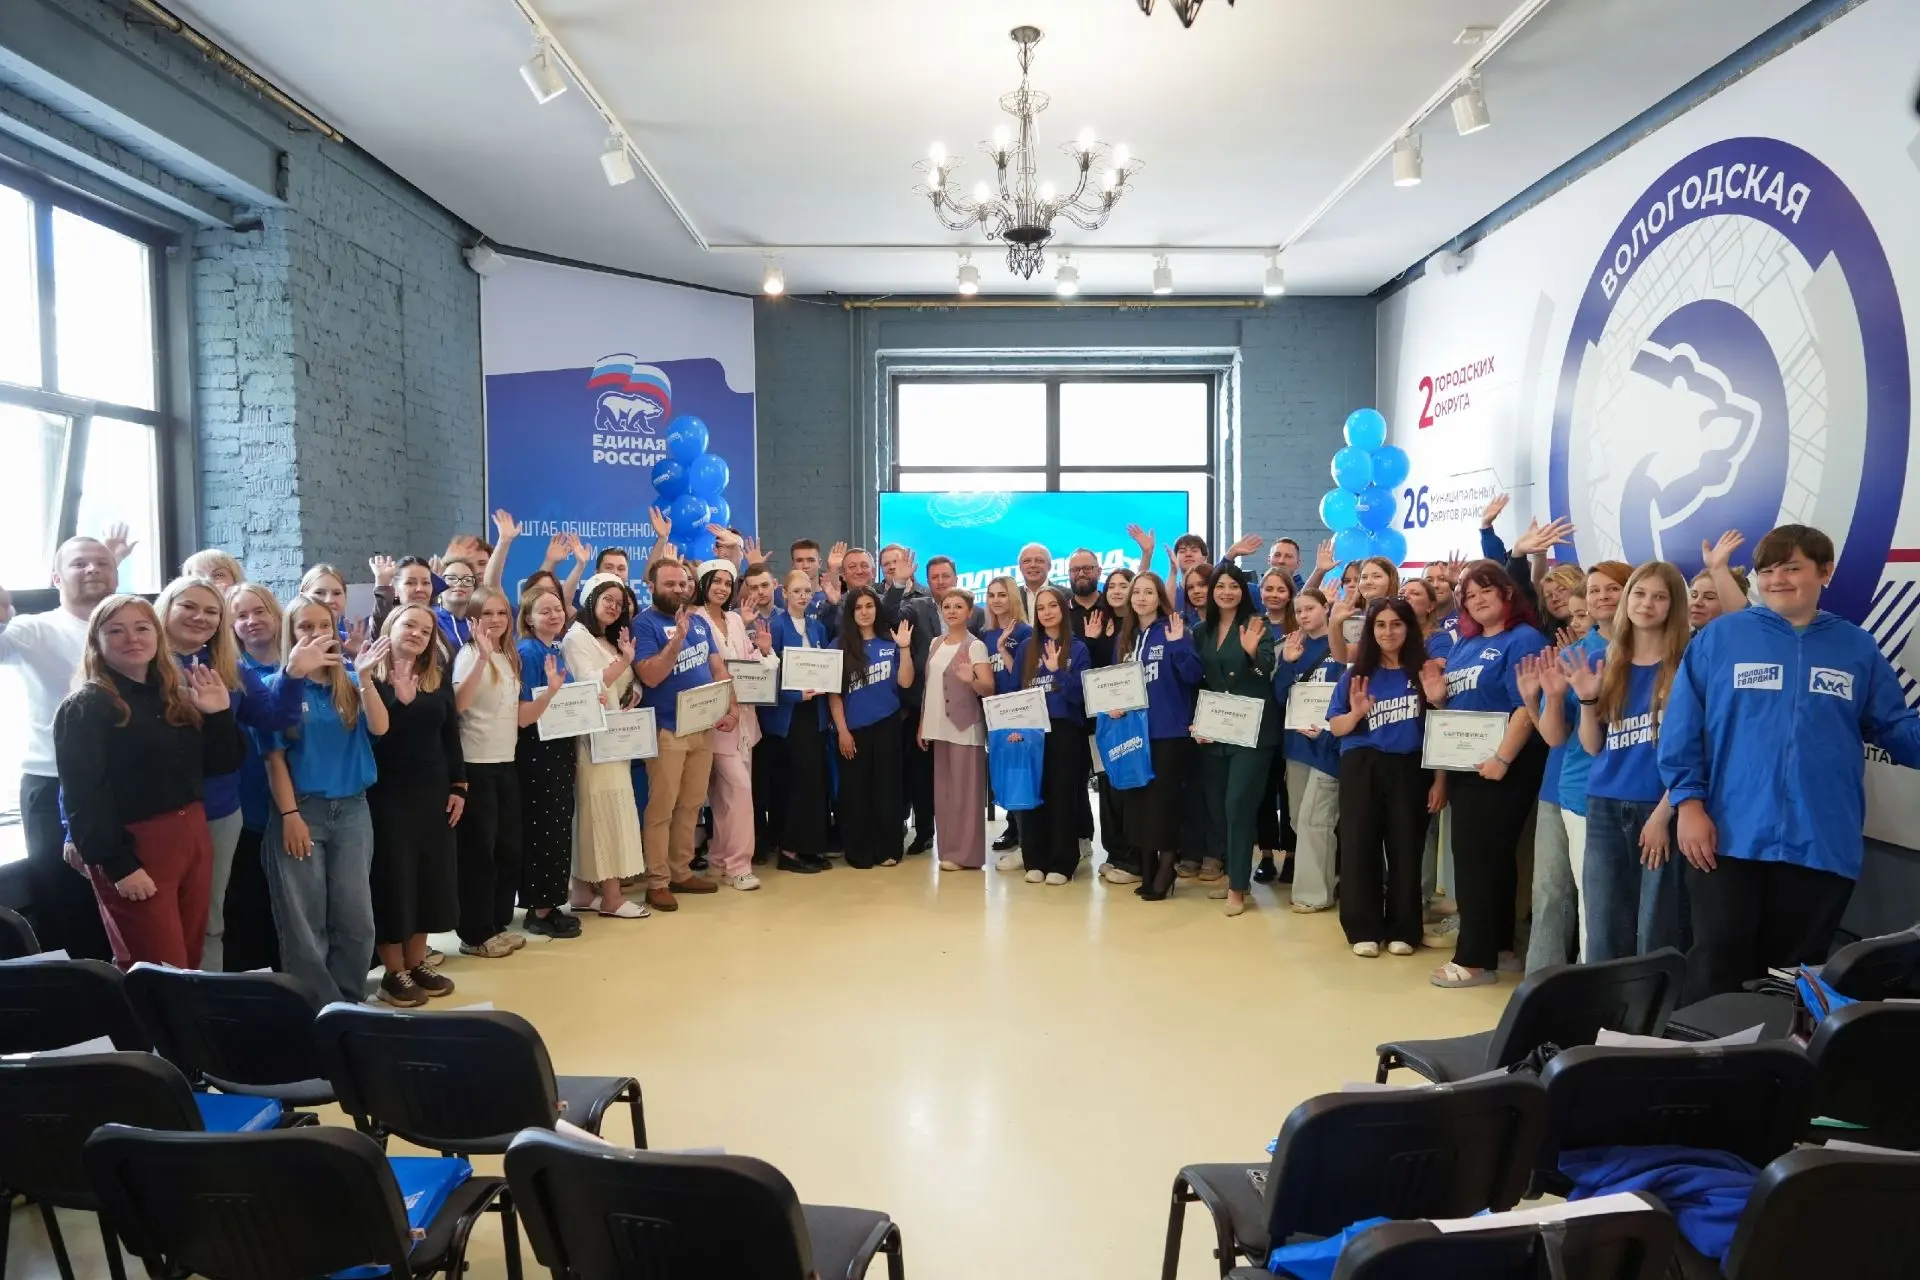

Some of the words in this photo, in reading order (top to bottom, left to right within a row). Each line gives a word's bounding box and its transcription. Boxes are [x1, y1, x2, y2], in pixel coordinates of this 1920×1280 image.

[1600, 163, 1811, 300] ВОЛОГОДСКАЯ
[1435, 356, 1495, 393] ГОРОДСКИХ
[1418, 376, 1433, 429] 2
[1434, 393, 1471, 418] ОКРУГА
[593, 433, 667, 451] ЕДИНАЯ
[1431, 485, 1496, 504] МУНИЦИПАЛЬНЫХ
[1403, 485, 1430, 530] 26
[1430, 508, 1460, 523] ОКРУГОВ
[519, 520, 557, 537] ШТАБ
[1737, 666, 1780, 680] МОЛОДАЯ
[1443, 730, 1489, 739] СЕРТИФИКАТ
